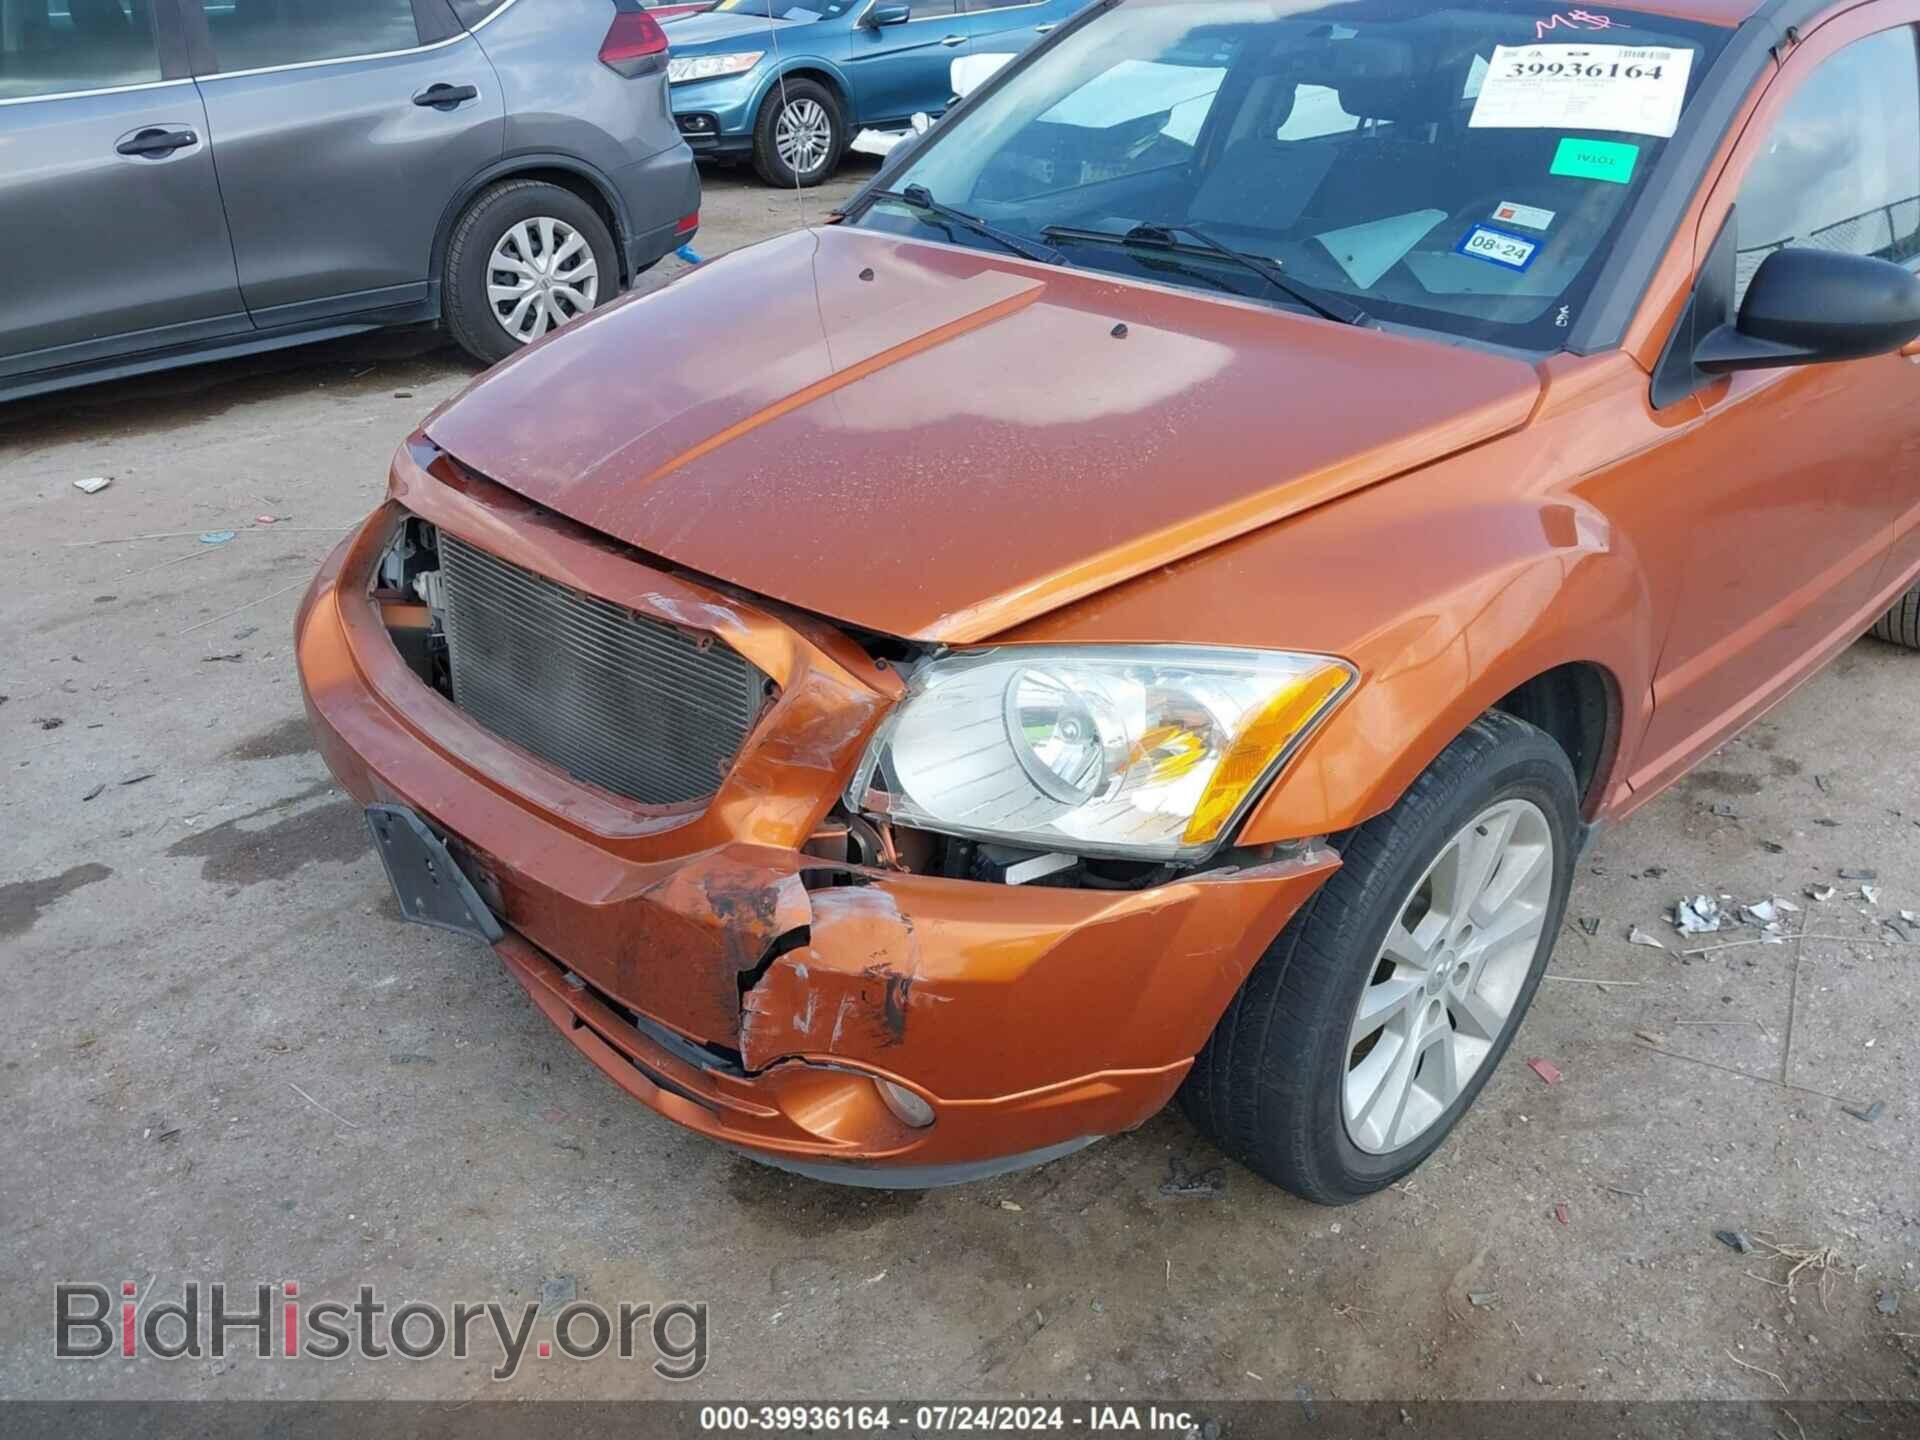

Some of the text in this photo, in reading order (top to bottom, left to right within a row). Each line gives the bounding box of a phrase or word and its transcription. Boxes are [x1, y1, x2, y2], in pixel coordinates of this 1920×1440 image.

[1506, 62, 1663, 80] 39936164
[1472, 236, 1527, 259] 08 24
